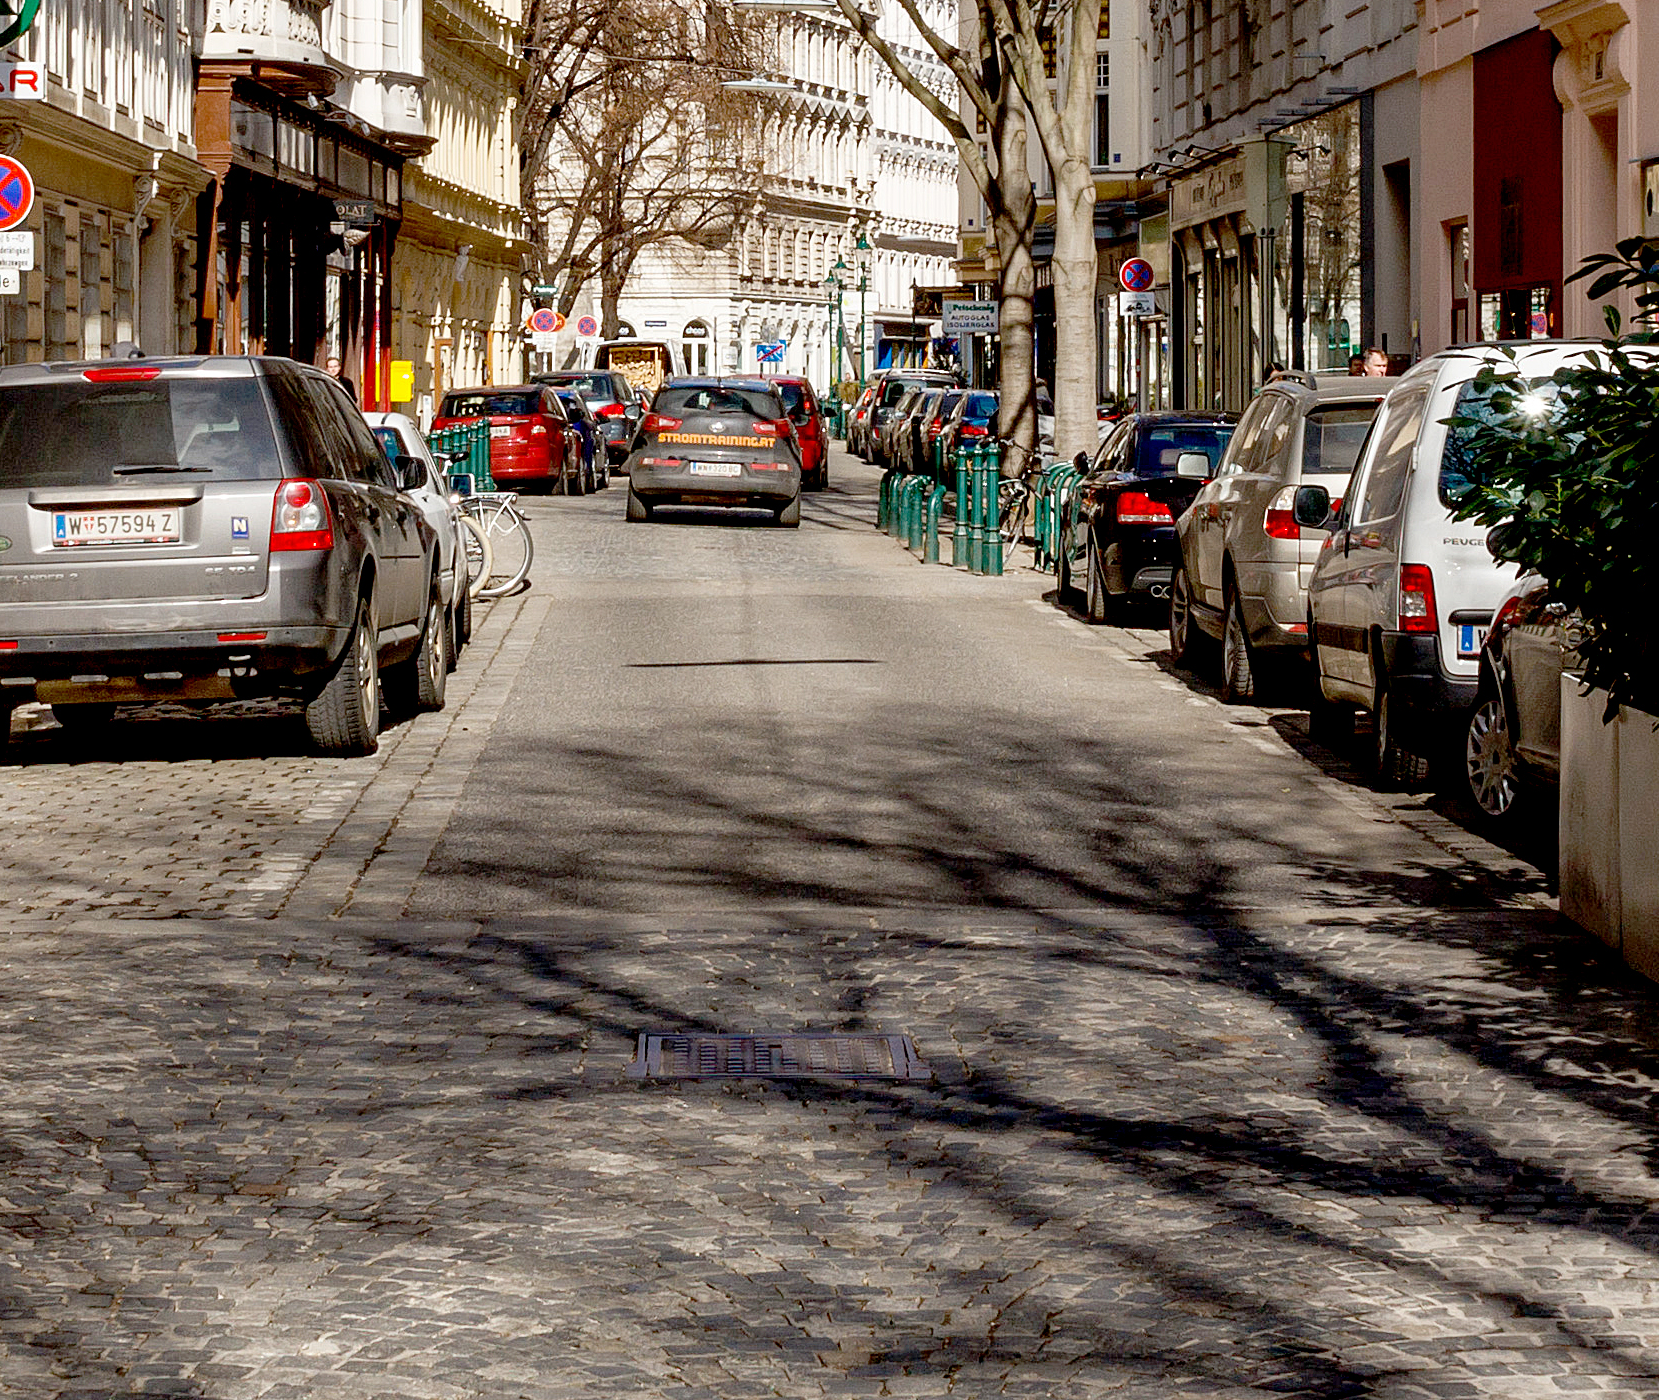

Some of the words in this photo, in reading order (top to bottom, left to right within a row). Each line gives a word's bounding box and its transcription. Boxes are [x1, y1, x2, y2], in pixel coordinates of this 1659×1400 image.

[657, 432, 776, 448] STROMTRAINING.AT
[69, 516, 82, 535] W
[97, 515, 156, 534] 57594
[161, 514, 172, 532] Z
[1443, 537, 1485, 547] PEUGE
